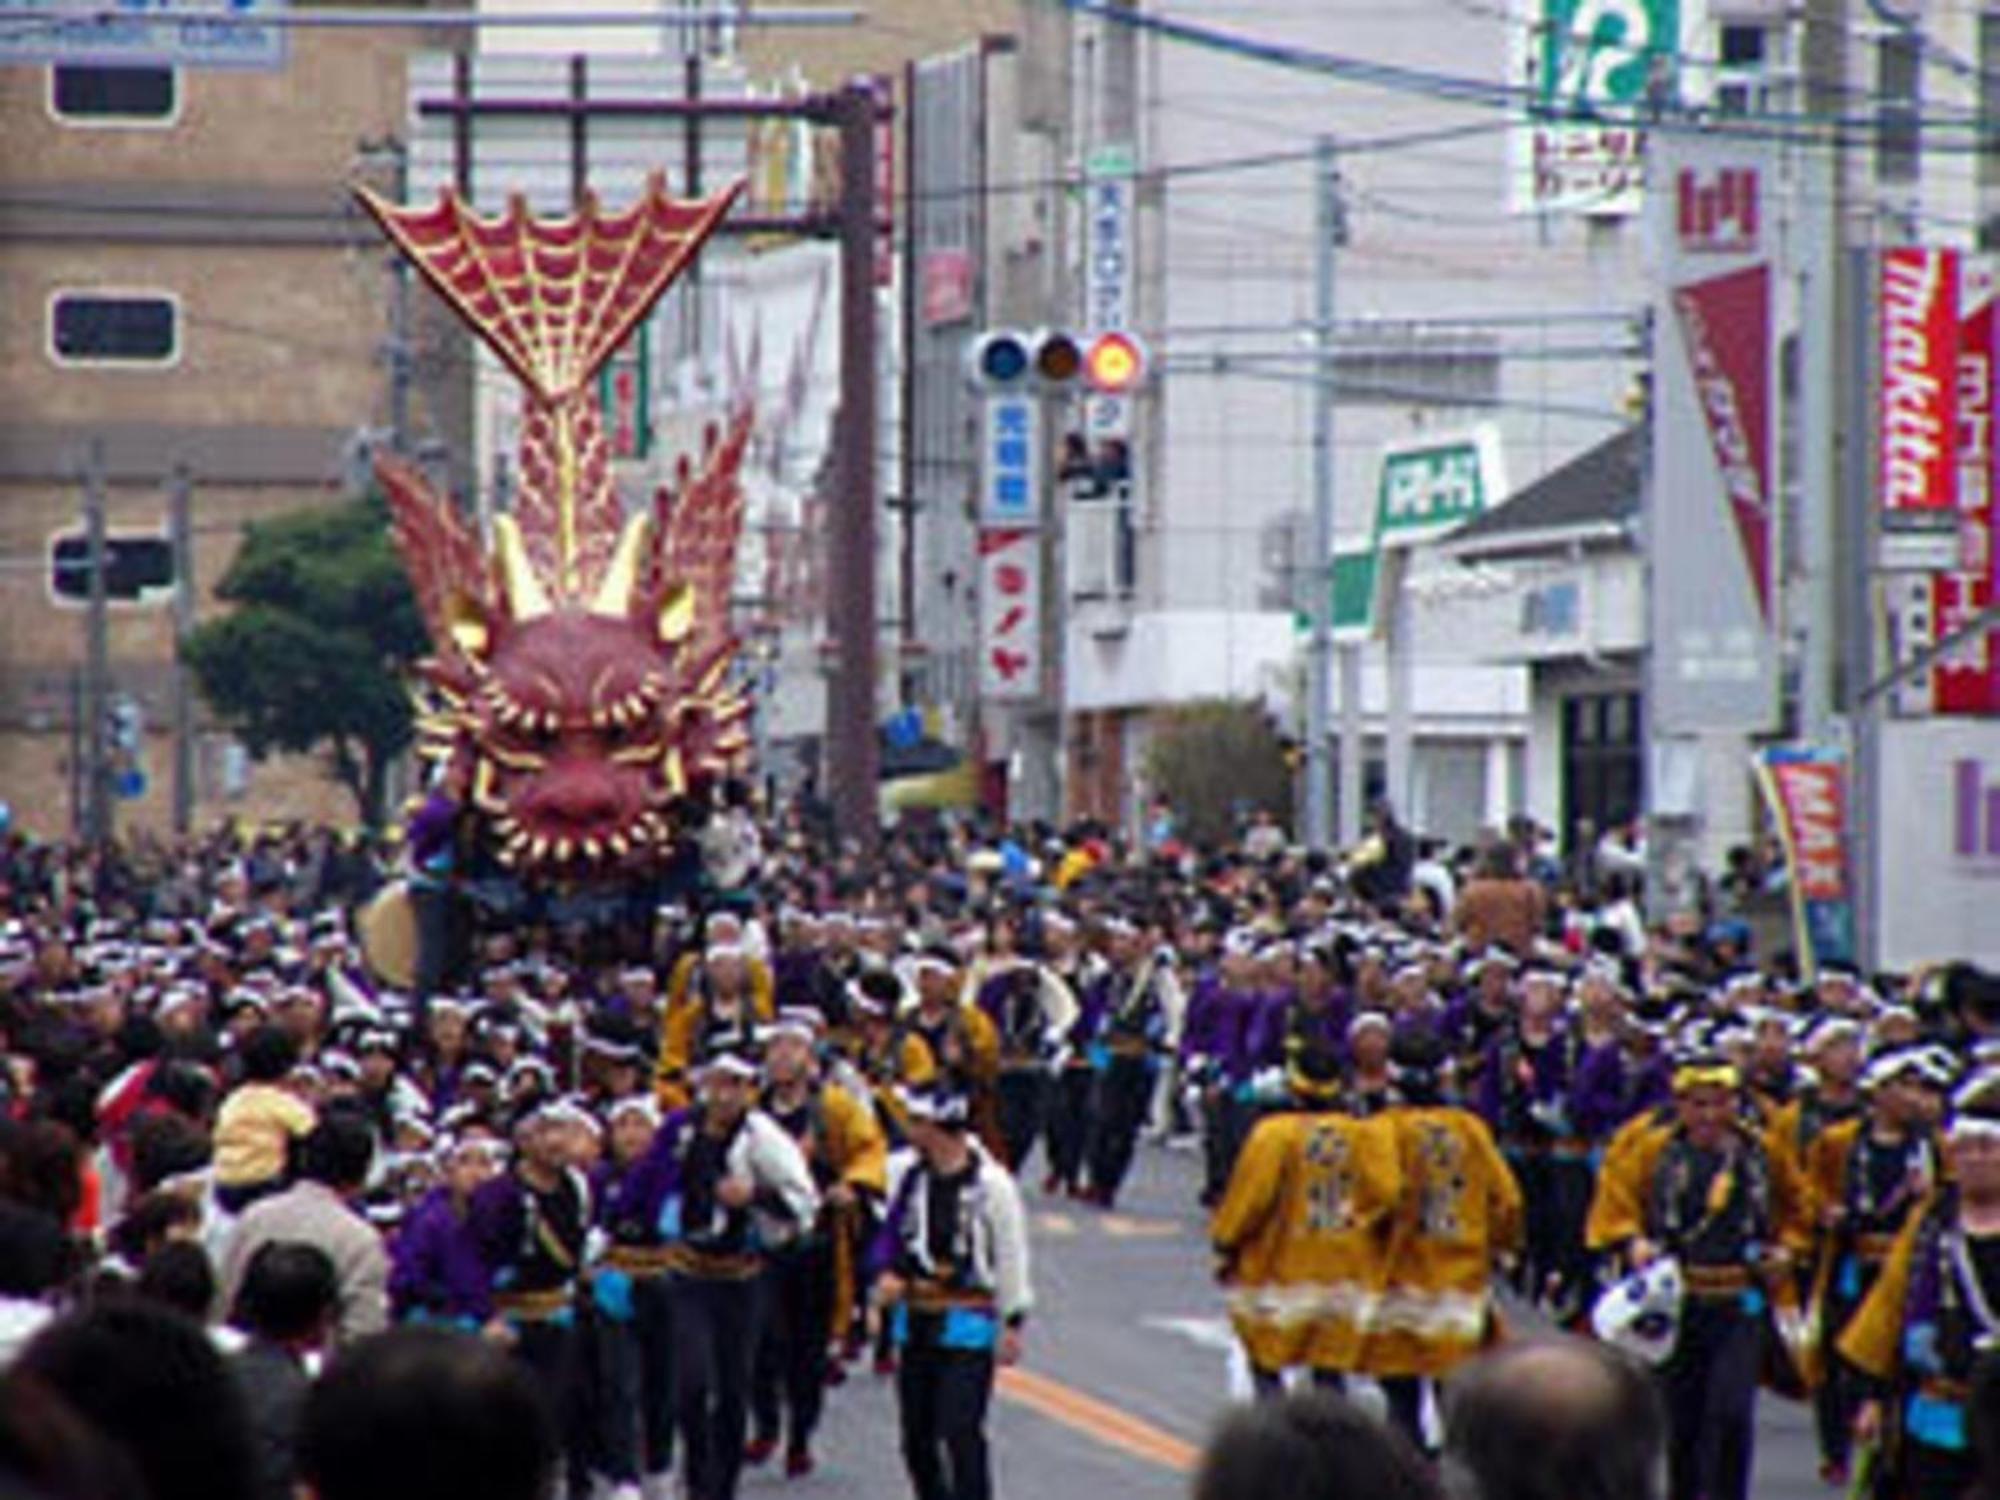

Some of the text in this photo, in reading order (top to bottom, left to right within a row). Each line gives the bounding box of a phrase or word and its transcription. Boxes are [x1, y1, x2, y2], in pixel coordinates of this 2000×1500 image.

[1093, 182, 1123, 428] 大手口クリク
[1885, 250, 1940, 508] makita
